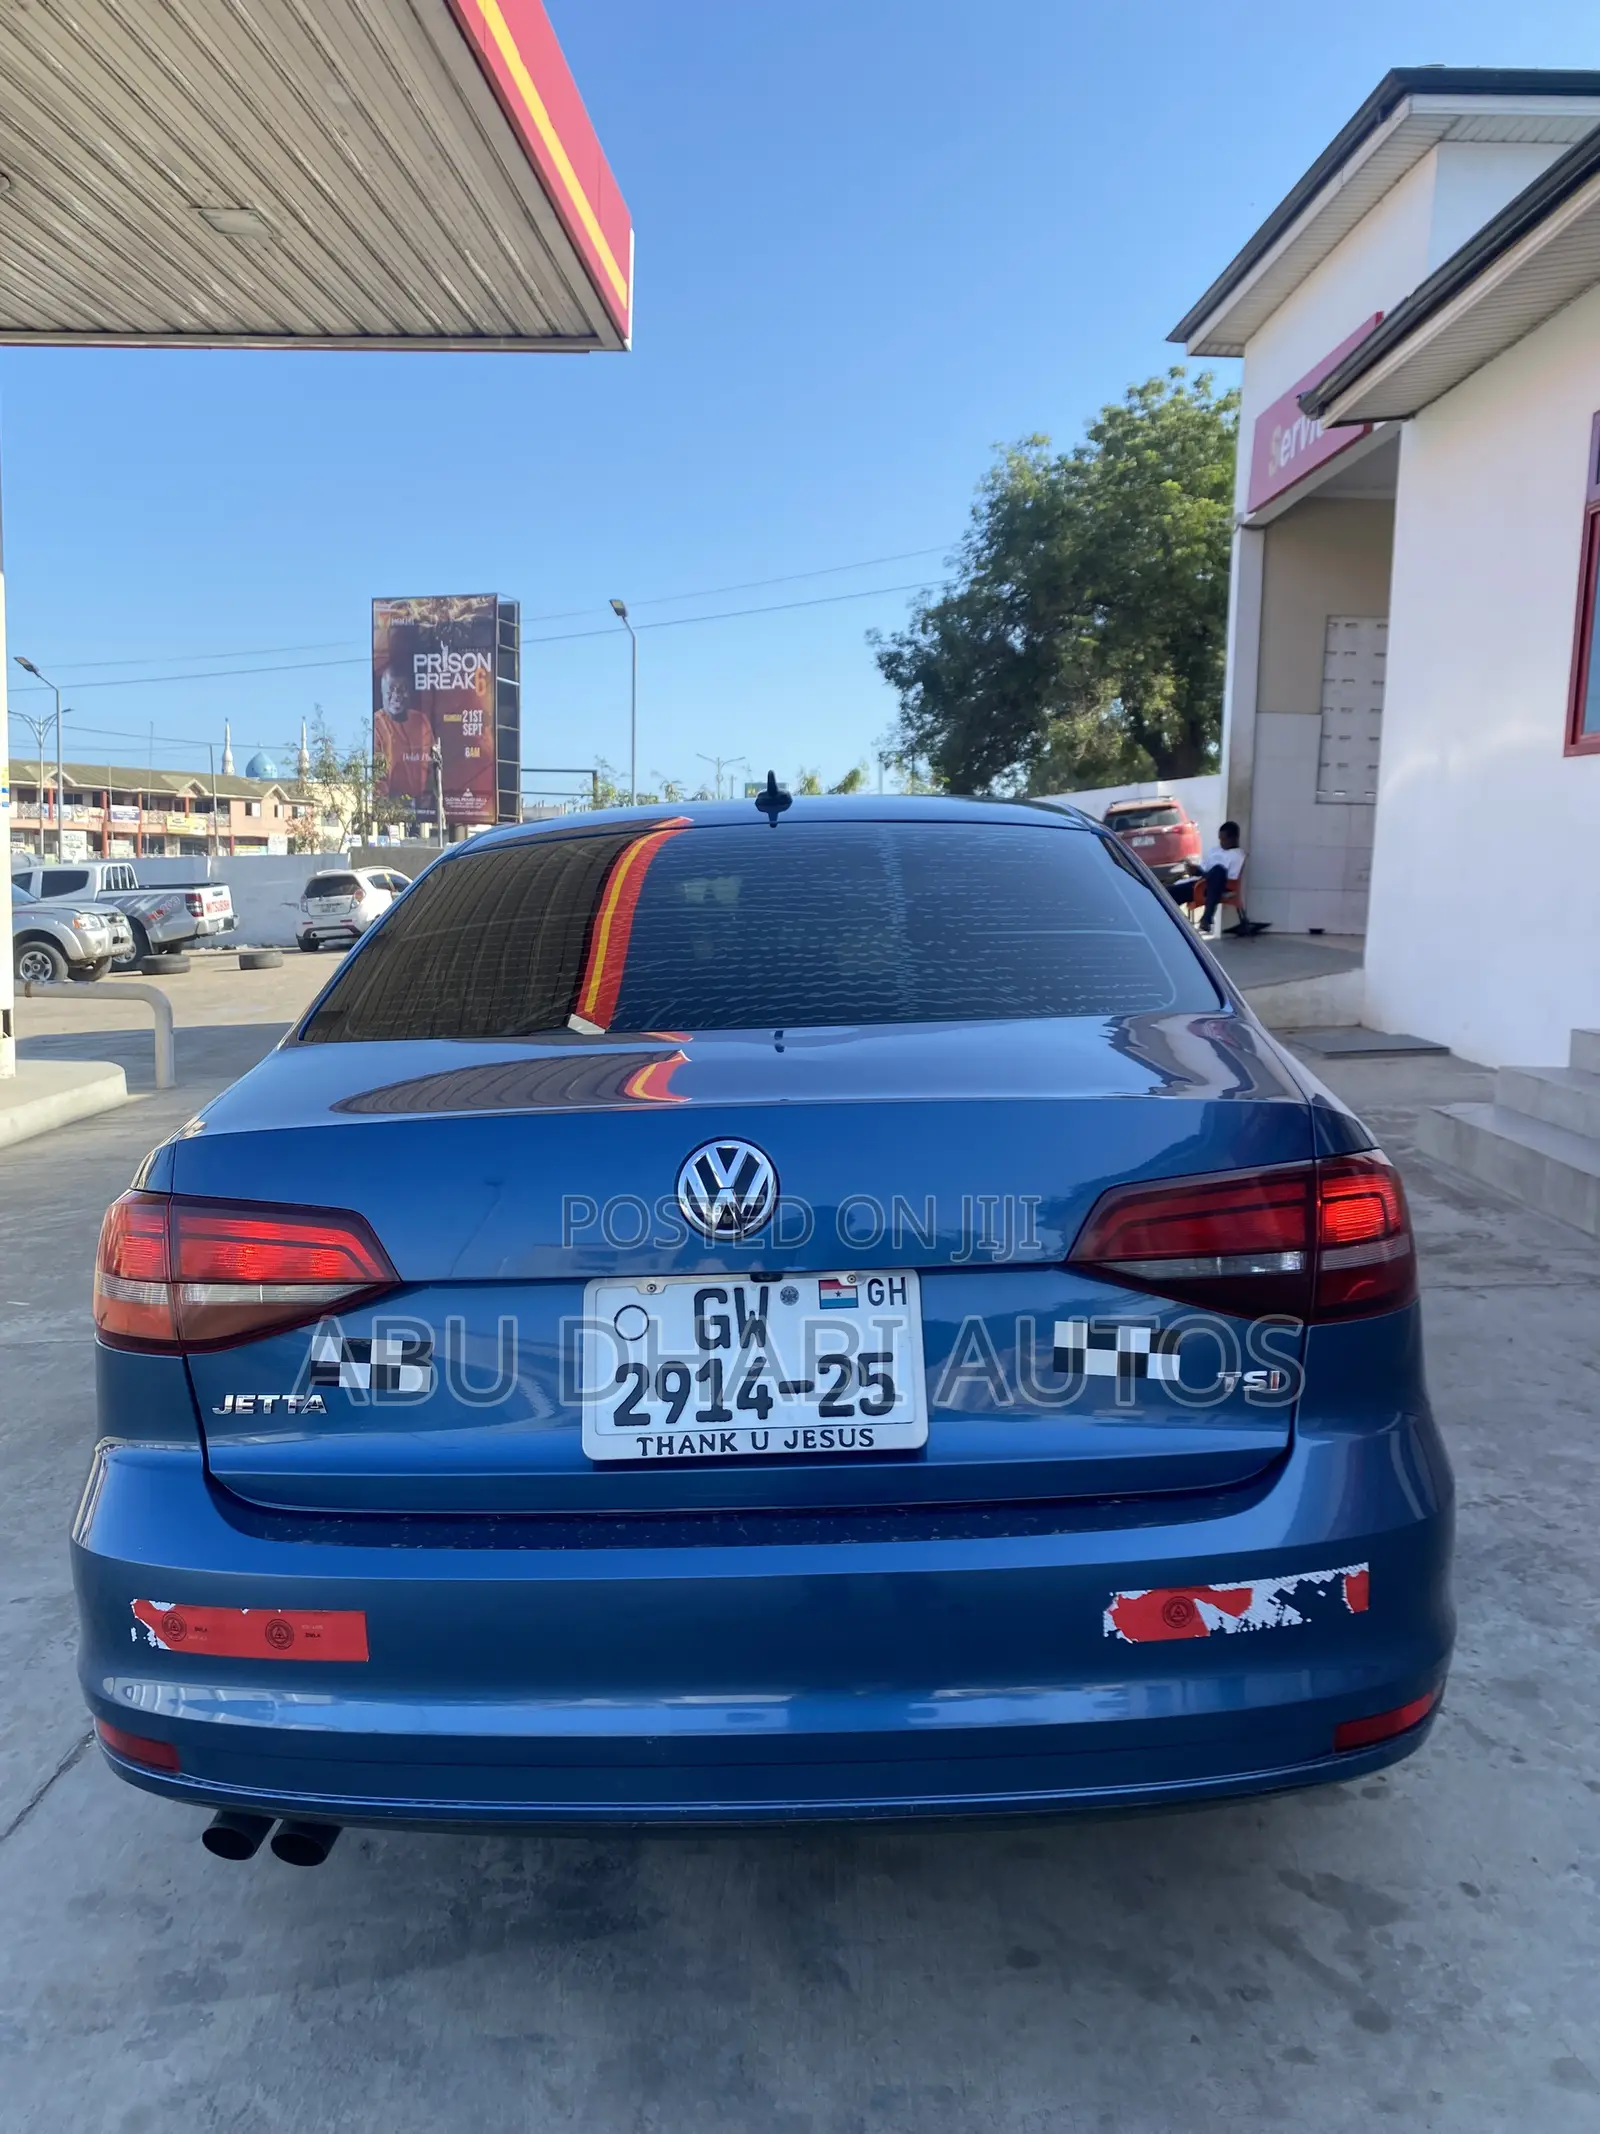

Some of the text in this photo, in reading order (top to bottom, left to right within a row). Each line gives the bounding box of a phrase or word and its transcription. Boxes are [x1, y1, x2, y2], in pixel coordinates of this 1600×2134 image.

[413, 649, 492, 673] PRISON
[415, 666, 487, 697] BREAK 6
[462, 709, 483, 723] 21ST
[462, 723, 483, 736] SEPT
[693, 1276, 907, 1350] GW GH
[613, 1351, 897, 1427] 2914-25
[1216, 1369, 1281, 1393] TSI
[211, 1393, 329, 1416] JETTA
[636, 1427, 875, 1457] THANK U JESUS
